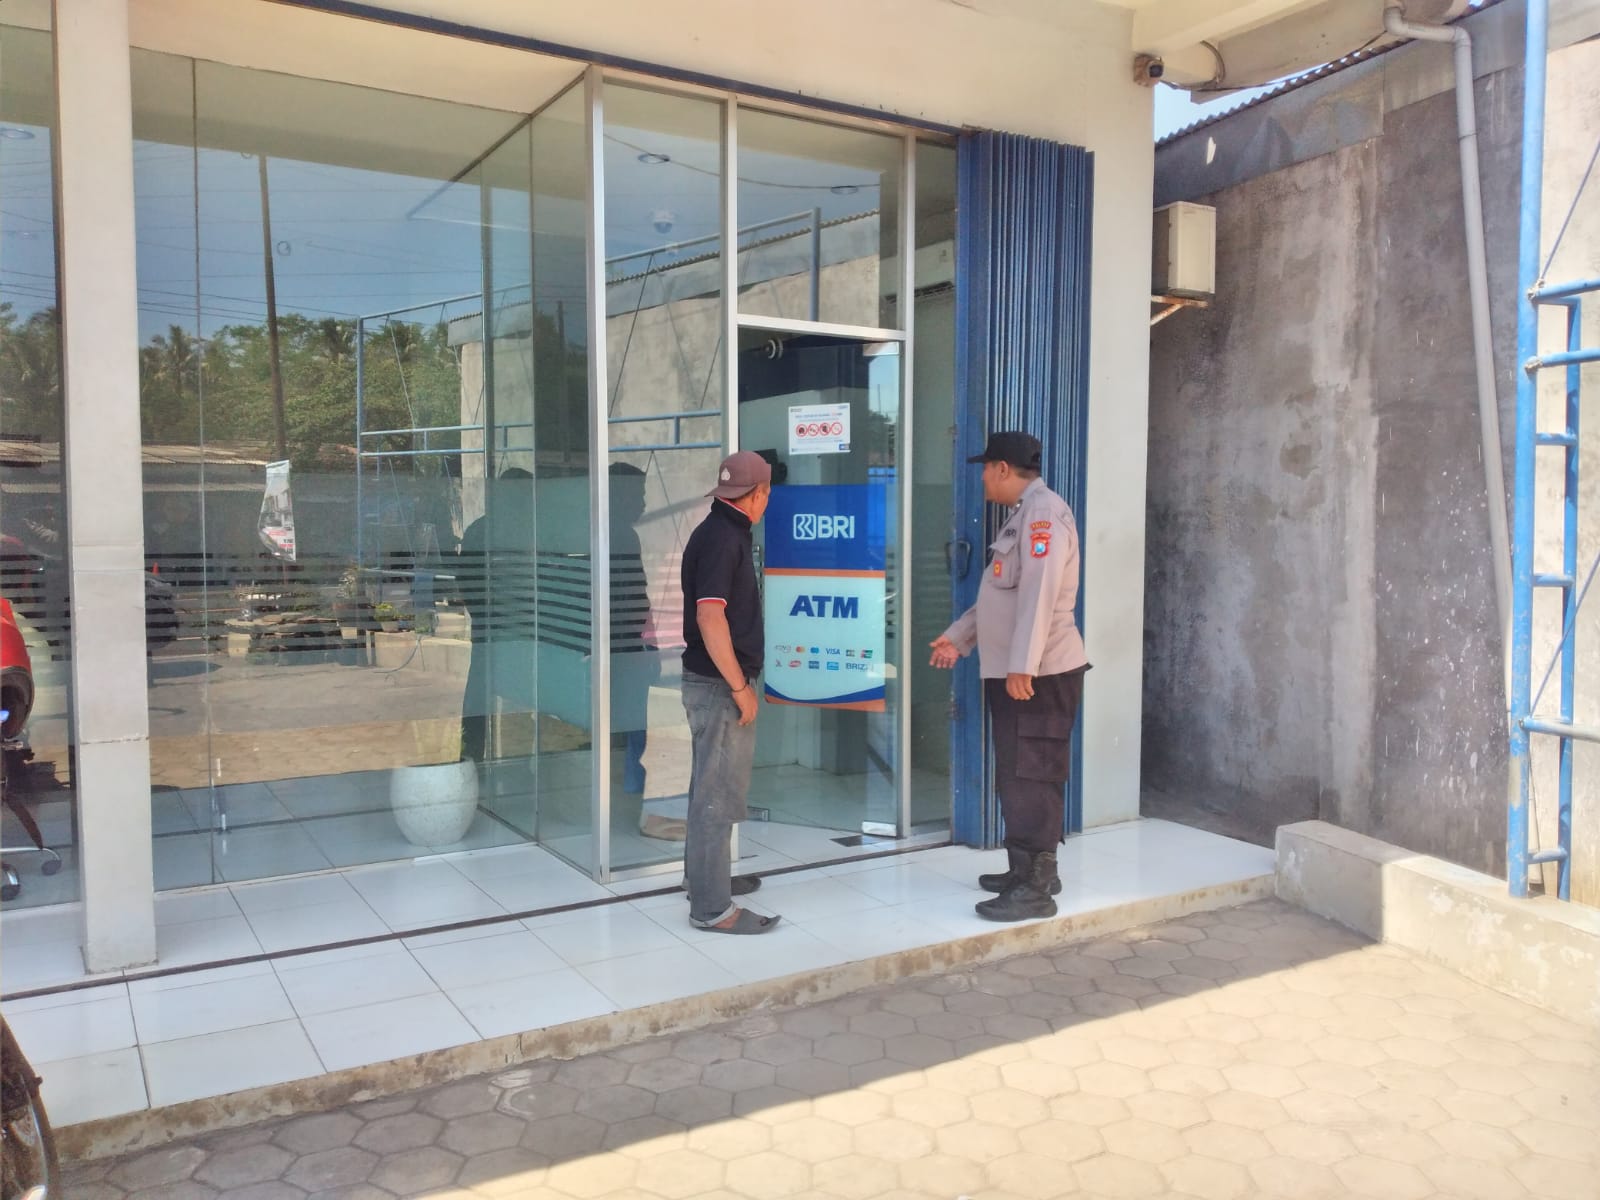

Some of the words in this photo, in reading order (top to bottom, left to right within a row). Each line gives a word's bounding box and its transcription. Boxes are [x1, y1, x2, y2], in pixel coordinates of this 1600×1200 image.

[817, 515, 855, 539] BRI
[789, 595, 859, 619] ATM
[846, 662, 874, 671] BRIZ
